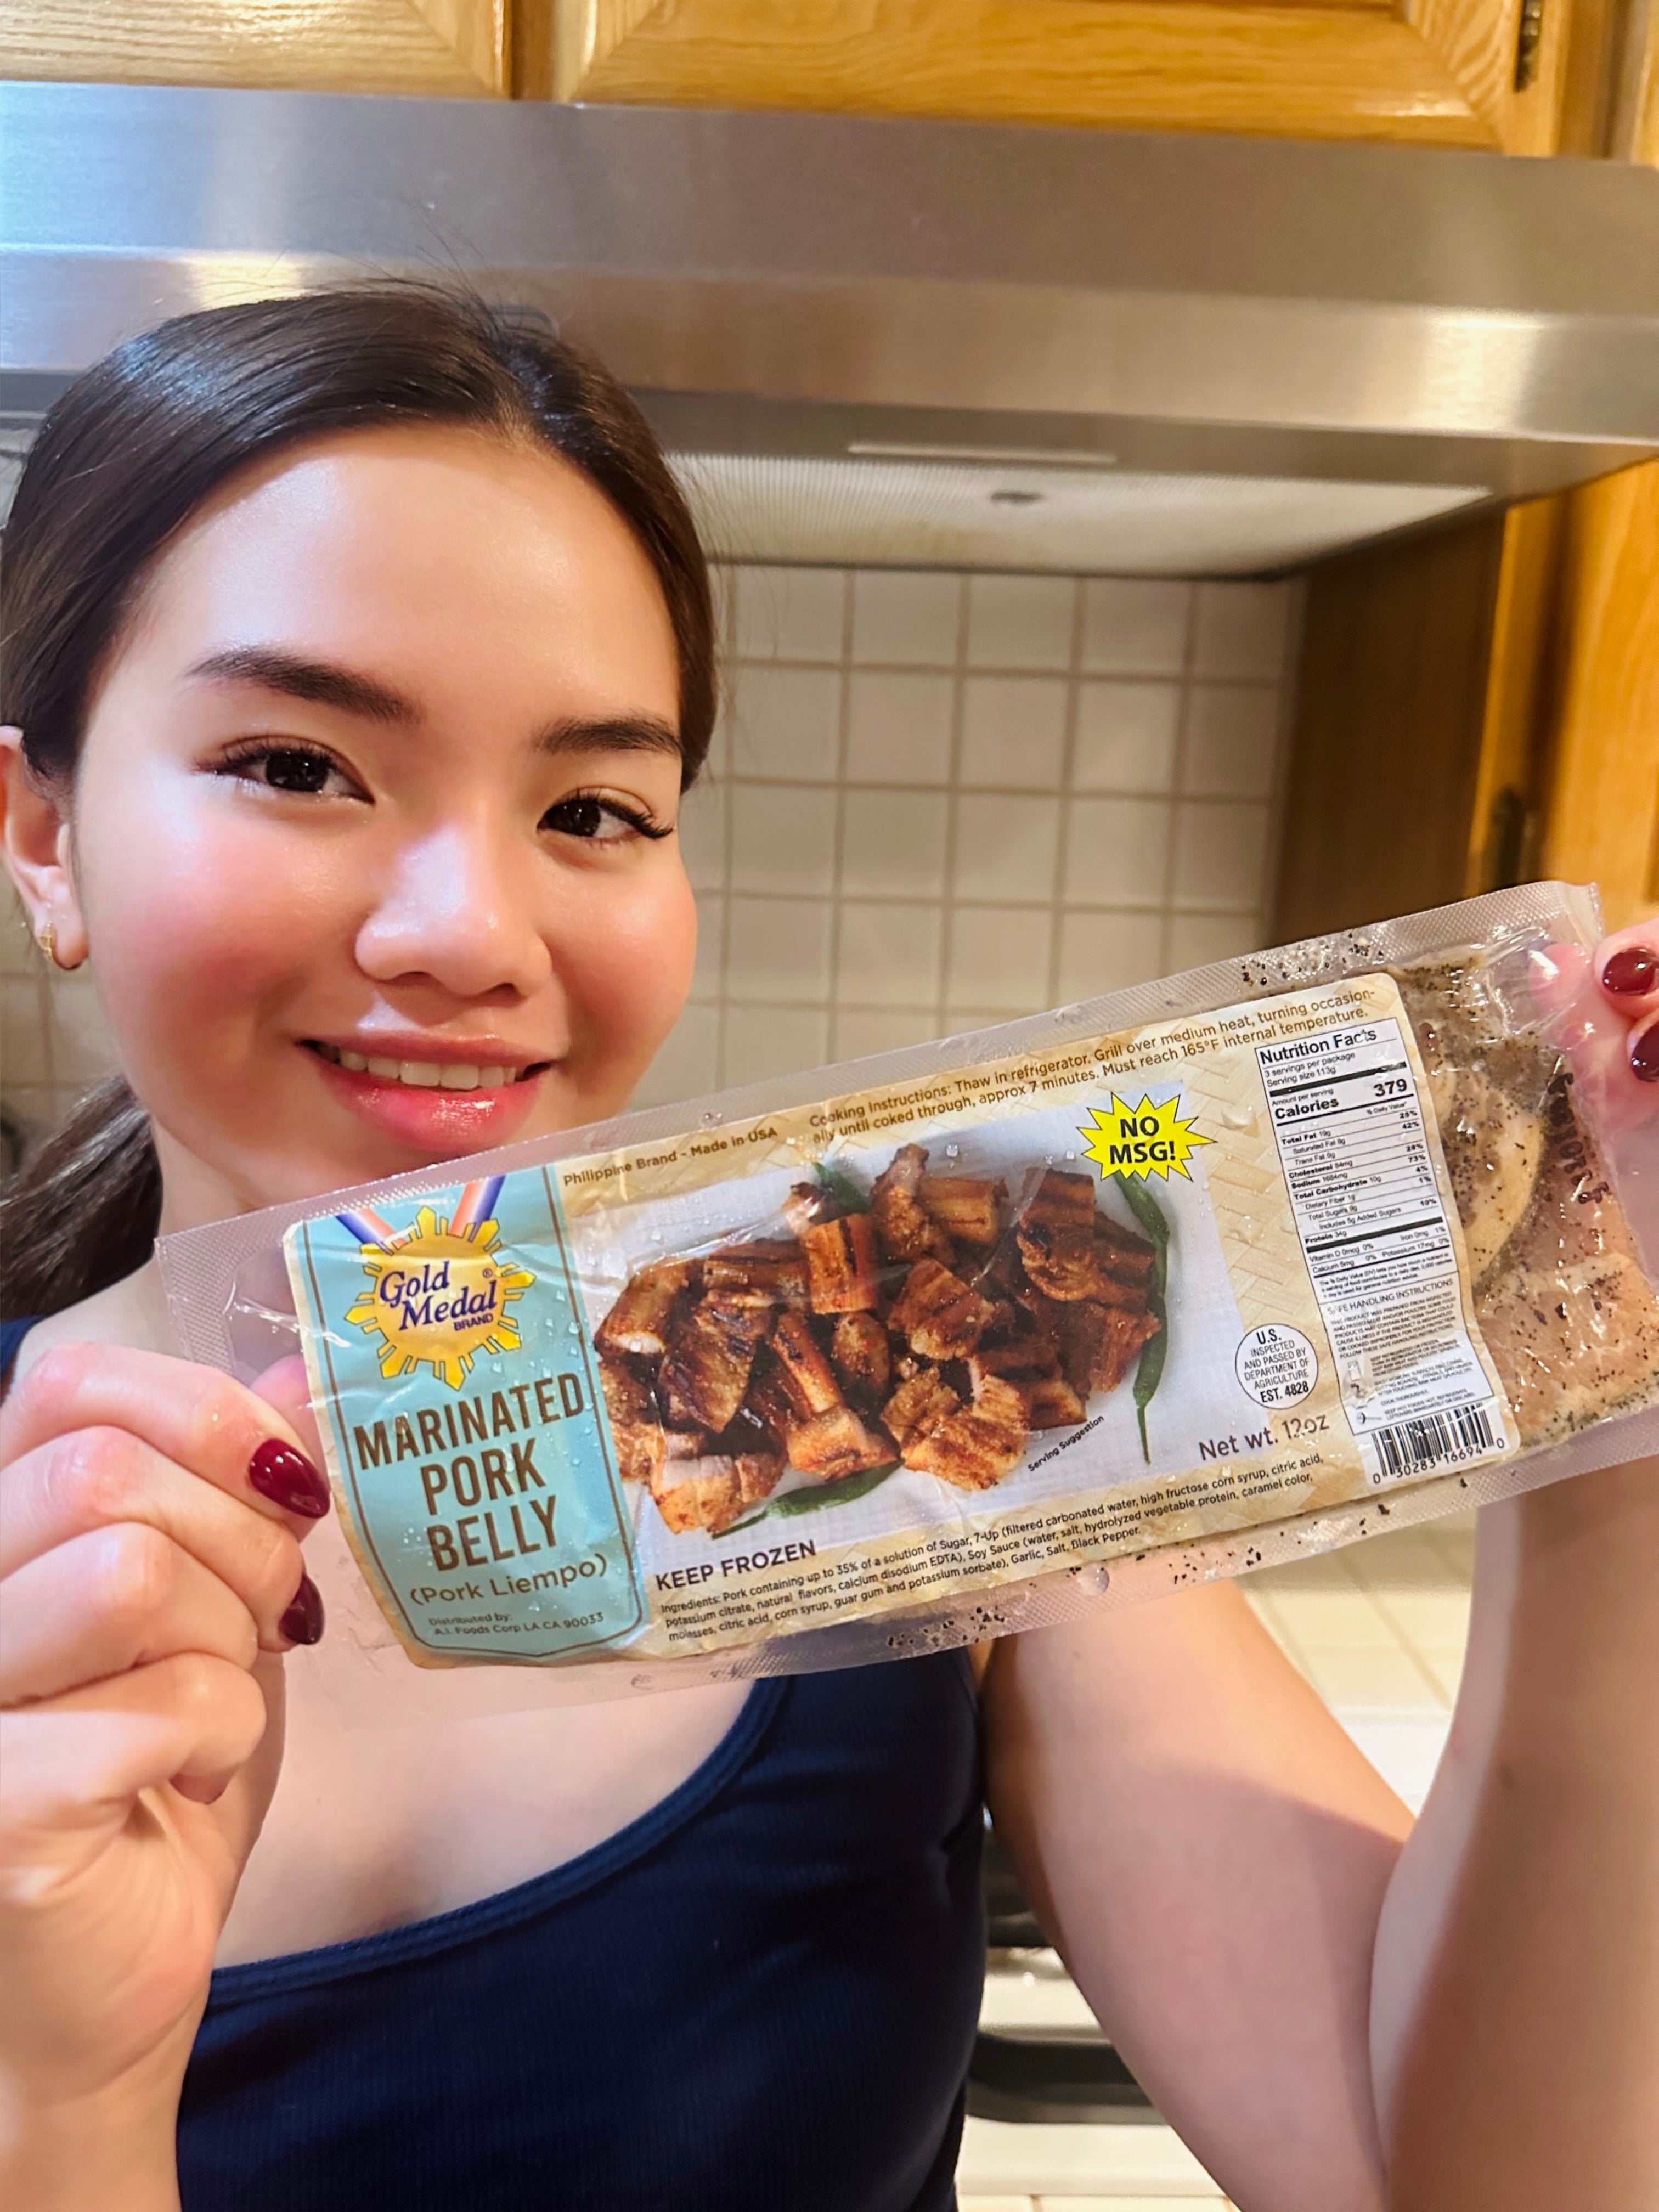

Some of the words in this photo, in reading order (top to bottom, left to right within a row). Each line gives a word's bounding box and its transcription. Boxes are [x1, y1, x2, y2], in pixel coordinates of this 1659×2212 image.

[810, 1105, 865, 1127] Cooking
[868, 1085, 951, 1113] Instructions:
[955, 1076, 990, 1093] Thaw
[995, 1071, 1007, 1085] in
[1012, 1054, 1091, 1081] refrigerator.
[1094, 1045, 1122, 1062] Grill
[1126, 1038, 1155, 1054] over
[1161, 1025, 1216, 1045] medium
[1219, 1014, 1256, 1033] heat,
[1257, 1003, 1308, 1023] turning
[1311, 990, 1375, 1012] occasion-
[1260, 1039, 1329, 1064] Nutrition
[1272, 1063, 1305, 1077] servings
[1307, 1060, 1320, 1072] per
[1322, 1052, 1356, 1068] package
[839, 1119, 870, 1137] until
[873, 1109, 915, 1129] coked
[917, 1096, 976, 1119] through,
[979, 1084, 1026, 1105] approx
[1029, 1081, 1037, 1092] 7
[1042, 1069, 1099, 1091] minutes.
[1103, 1058, 1136, 1076] Must
[1140, 1048, 1178, 1067] reach
[1182, 1038, 1220, 1057] 165°F
[1223, 1025, 1277, 1048] internal
[1279, 1008, 1368, 1035] temperature.
[1267, 1074, 1297, 1087] Serving
[1299, 1070, 1316, 1080] size
[1317, 1066, 1336, 1077] 113g
[1272, 1094, 1296, 1107] Amount
[1298, 1093, 1308, 1102] per
[1311, 1087, 1334, 1098] serving
[1275, 1098, 1339, 1119] Calories
[1374, 1079, 1407, 1097] 379
[1119, 1116, 1159, 1138] NO
[1281, 1136, 1302, 1145] Total
[563, 1162, 633, 1187] Philippine
[636, 1150, 678, 1170] Brand
[690, 1139, 728, 1156] Made
[732, 1135, 745, 1147] in
[748, 1127, 778, 1143] USA
[1110, 1141, 1175, 1164] MSG!
[1294, 1190, 1314, 1200] Total
[380, 1260, 450, 1308] Gold
[1350, 1294, 1395, 1310] HANDLING
[1396, 1279, 1453, 1298] INSTRUCTIONS
[399, 1280, 497, 1330] Medal
[453, 1313, 494, 1331] BRAND
[1256, 1328, 1282, 1344] U.S.
[1244, 1359, 1261, 1370] AND
[1263, 1351, 1294, 1364] PASSED
[1296, 1347, 1306, 1357] BY
[1250, 1340, 1295, 1357] INSPECTED
[1244, 1362, 1297, 1380] DEPARTMENT
[1299, 1358, 1309, 1367] OF
[1254, 1369, 1309, 1390] AGRICULTURE
[1260, 1388, 1283, 1403] EST.
[1285, 1381, 1308, 1397] 4828
[354, 1372, 585, 1470] MARINATED
[1028, 1447, 1059, 1471] Serving
[1059, 1415, 1104, 1449] Suggestion
[1199, 1435, 1239, 1460] Net
[1245, 1427, 1278, 1449] wt.
[1373, 1472, 1381, 1484] 0
[1396, 1457, 1436, 1478] 30283
[1443, 1447, 1482, 1464] 16694
[1496, 1437, 1504, 1449] 0
[420, 1438, 546, 1515] PORK
[427, 1494, 557, 1571] BELLY
[661, 1596, 720, 1613] Ingredients:
[723, 1589, 748, 1601] Pork
[750, 1576, 804, 1595] containing
[807, 1572, 820, 1583] up
[822, 1569, 834, 1578] to
[836, 1561, 858, 1575] 35%
[861, 1558, 872, 1569] of
[874, 1558, 881, 1566] a
[883, 1547, 924, 1564] solution
[927, 1541, 938, 1551] of
[940, 1537, 973, 1550] Sugar,
[974, 1531, 999, 1543] 7-Up
[1002, 1519, 1043, 1536] (filtered
[1046, 1505, 1104, 1527] carbonated
[1107, 1498, 1138, 1511] water,
[1141, 1490, 1163, 1504] high
[1166, 1482, 1209, 1499] fructose
[1212, 1477, 1234, 1489] corn
[1237, 1470, 1269, 1484] syrup,
[1272, 1461, 1297, 1475] citric
[1300, 1453, 1323, 1466] acid,
[656, 1564, 714, 1591] KEEP
[720, 1539, 816, 1577] FROZEN
[665, 1611, 715, 1627] potassium
[719, 1604, 755, 1617] citrate,
[757, 1594, 793, 1609] natural
[798, 1584, 837, 1599] flavors,
[839, 1574, 878, 1590] calcium
[881, 1561, 928, 1579] disodium
[968, 1549, 986, 1561] Soy
[990, 1540, 1020, 1555] Sauce
[1023, 1532, 1059, 1547] (water,
[1060, 1525, 1082, 1537] salt,
[1085, 1510, 1141, 1532] hydrolyzed
[1144, 1498, 1195, 1518] vegetable
[1198, 1491, 1239, 1506] protein,
[1241, 1480, 1282, 1497] caramel
[1285, 1474, 1313, 1487] color,
[410, 1581, 484, 1606] (Pork
[490, 1553, 608, 1597] Liempo)
[719, 1618, 744, 1631] citric
[748, 1614, 772, 1626] acid,
[775, 1609, 798, 1620] corn
[800, 1601, 832, 1615] syrup,
[834, 1595, 857, 1608] guar
[860, 1589, 883, 1601] gum
[887, 1581, 905, 1593] and
[909, 1570, 960, 1590] potassium
[962, 1559, 1009, 1575] sorbate),
[1011, 1550, 1045, 1564] Garlic,
[1046, 1544, 1069, 1556] Salt,
[1071, 1536, 1100, 1550] Black
[1103, 1526, 1141, 1543] Pepper.
[429, 1613, 492, 1626] Distributed
[495, 1612, 512, 1622] by:
[456, 1626, 490, 1635] Foods
[493, 1624, 520, 1634] Corp
[523, 1622, 540, 1632] LA
[542, 1621, 561, 1630] CA
[563, 1612, 604, 1629] 90033
